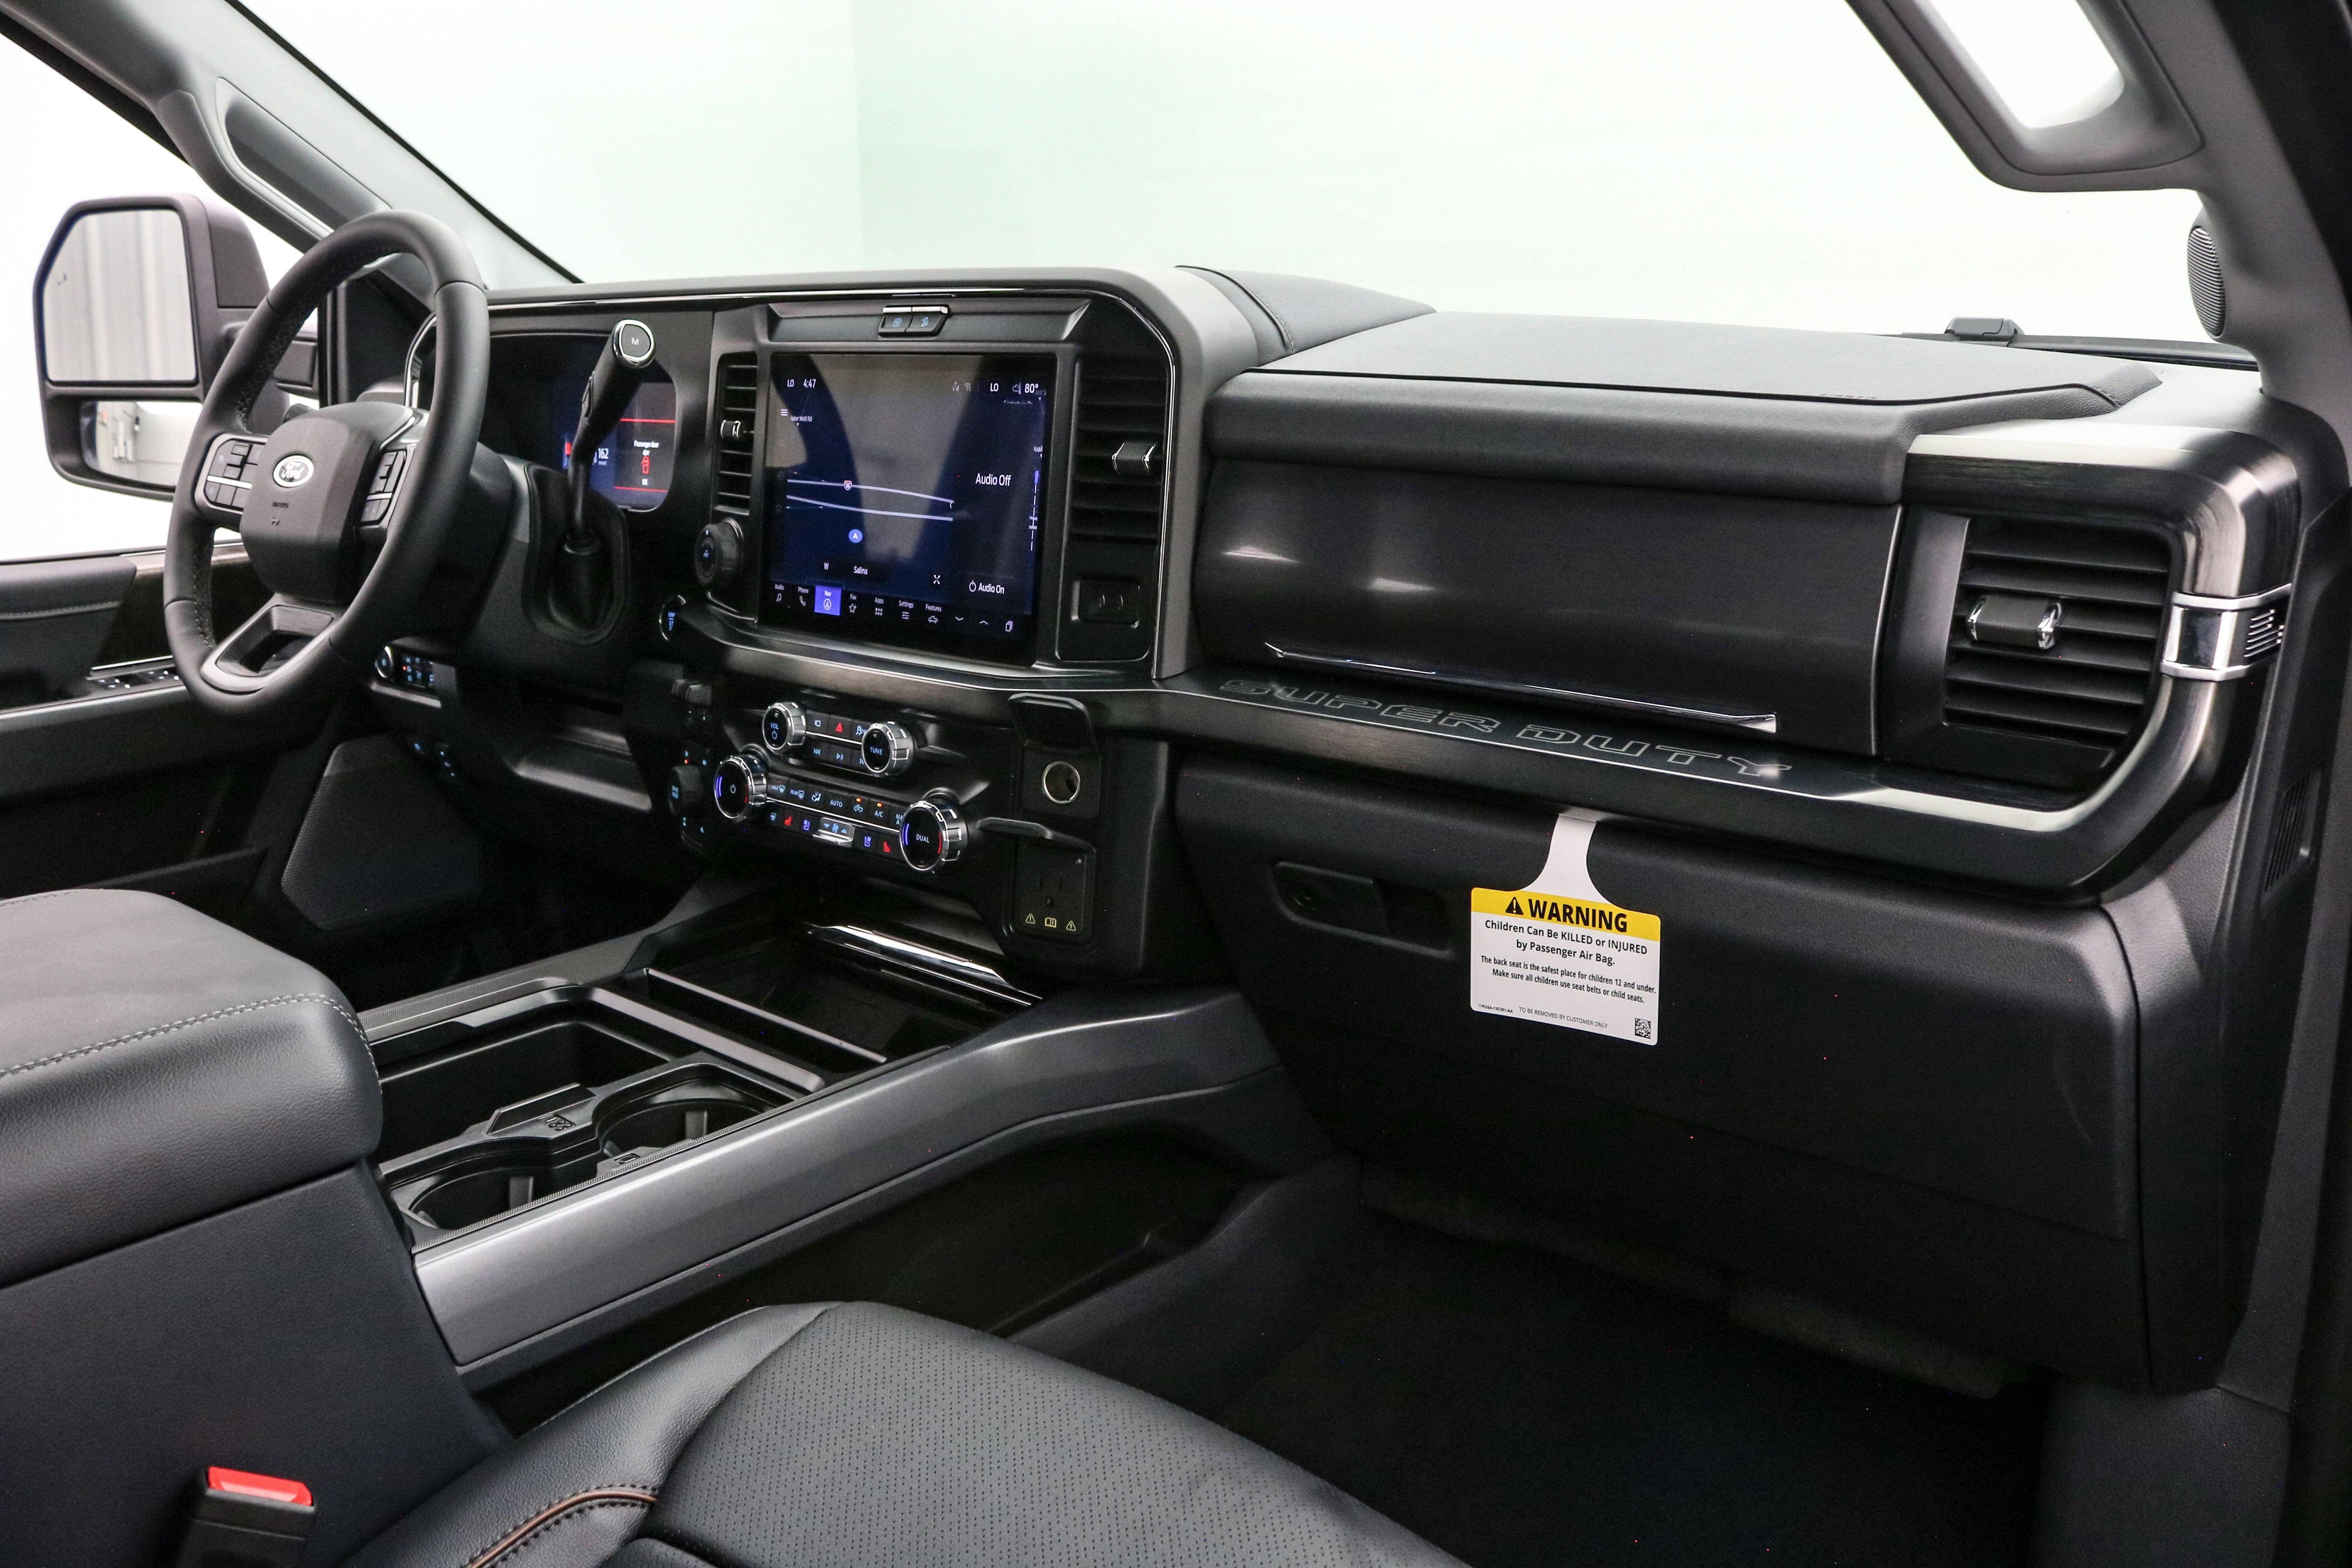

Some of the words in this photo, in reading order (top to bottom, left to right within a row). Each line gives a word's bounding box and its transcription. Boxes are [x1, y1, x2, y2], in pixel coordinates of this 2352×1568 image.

[803, 379, 816, 388] 4:47
[990, 383, 998, 392] LO
[598, 448, 608, 459] 162
[282, 462, 304, 479] Ford
[976, 473, 998, 485] Audio
[999, 475, 1011, 486] Off
[854, 566, 868, 575] Salina
[978, 583, 995, 592] Audio
[996, 585, 1004, 594] On
[1220, 680, 1501, 733] SUPER
[1516, 724, 1792, 776] DUTY
[870, 747, 883, 755] TUNE
[830, 799, 843, 807] AUTO
[916, 834, 930, 843] DUAL
[1528, 898, 1627, 933] WARNING
[1485, 920, 1524, 933] Children
[1527, 926, 1544, 936] Can
[1547, 929, 1558, 939] Be
[1561, 931, 1593, 944] KILLED
[1608, 939, 1647, 954] INJURED
[1517, 939, 1528, 951] by
[1530, 942, 1577, 958] Passenger
[1579, 950, 1593, 960] Air
[1596, 953, 1615, 966] Bag.
[1481, 956, 1492, 964] The
[1494, 957, 1508, 966] back
[1530, 963, 1540, 971] the
[1541, 966, 1559, 975] safest
[1561, 969, 1576, 978] place
[1578, 971, 1587, 980] for
[1588, 973, 1613, 985] children
[1615, 978, 1622, 987] 12
[1624, 981, 1635, 989] and
[1637, 984, 1657, 994] under.
[1492, 969, 1509, 978] Make
[1535, 976, 1558, 986] children
[1572, 983, 1585, 991] seat
[1586, 984, 1601, 994] belts
[1611, 990, 1626, 999] child
[1627, 993, 1645, 1003] seats.
[1535, 1009, 1558, 1019] REMOVED
[1566, 1016, 1593, 1026] CUSTOMER
